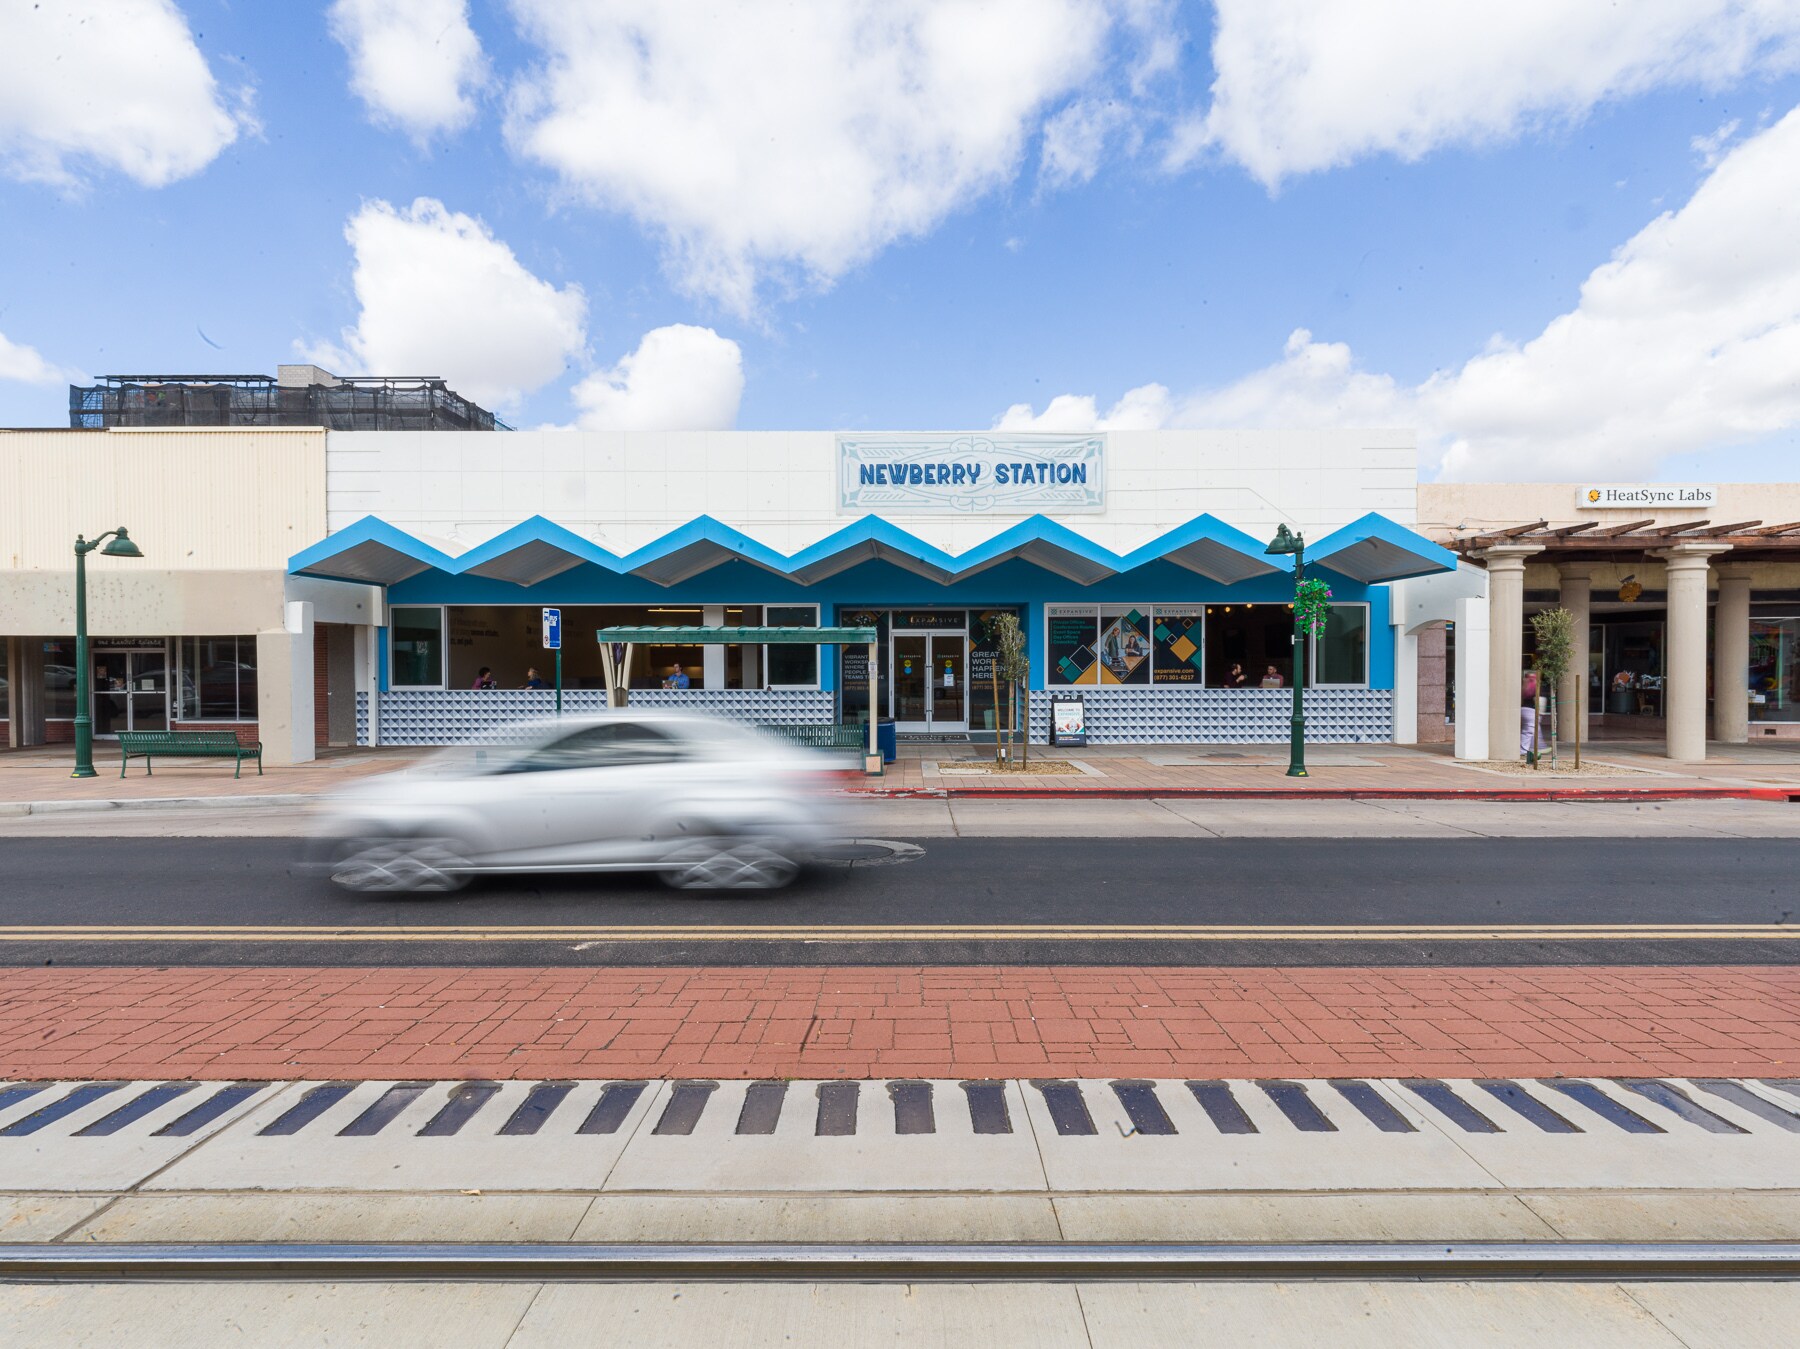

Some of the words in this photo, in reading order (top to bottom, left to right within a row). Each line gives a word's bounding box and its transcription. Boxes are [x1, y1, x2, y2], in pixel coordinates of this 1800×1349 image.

[860, 463, 981, 485] NEWBERRY
[995, 463, 1087, 485] STATION
[1606, 489, 1674, 504] HeatSync
[1679, 488, 1712, 501] Labs
